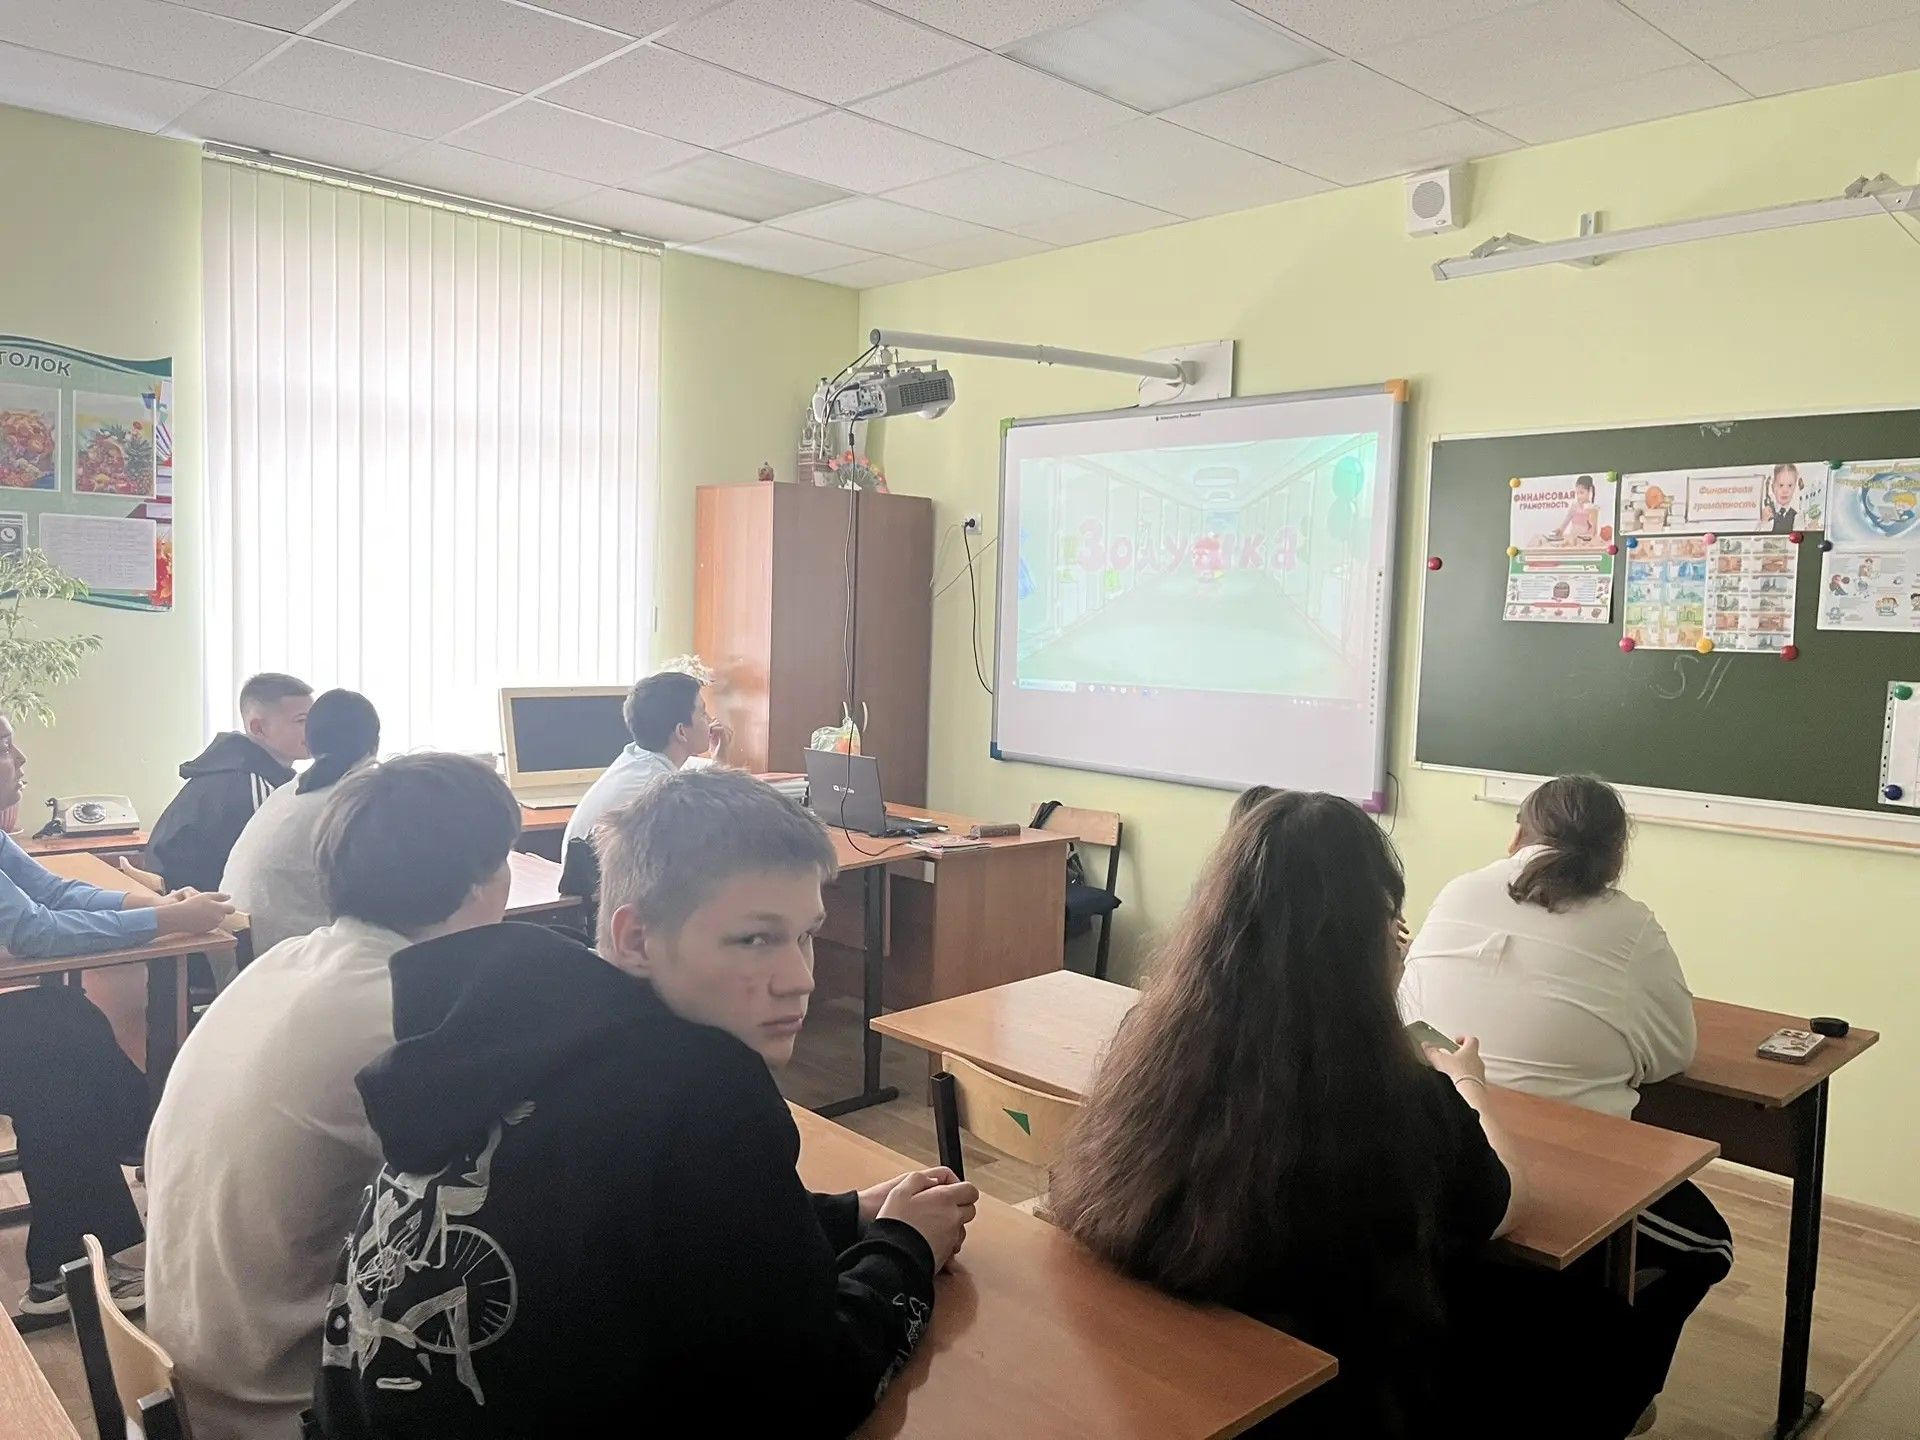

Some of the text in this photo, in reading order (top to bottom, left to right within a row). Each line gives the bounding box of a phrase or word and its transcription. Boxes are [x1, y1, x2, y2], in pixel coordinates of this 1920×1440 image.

[1699, 485, 1753, 494] Финансовая
[1513, 491, 1576, 502] ФИНАНСОВАЯ
[1519, 502, 1569, 510] ГРАМОТНОСТЬ
[1693, 501, 1757, 512] грамотность
